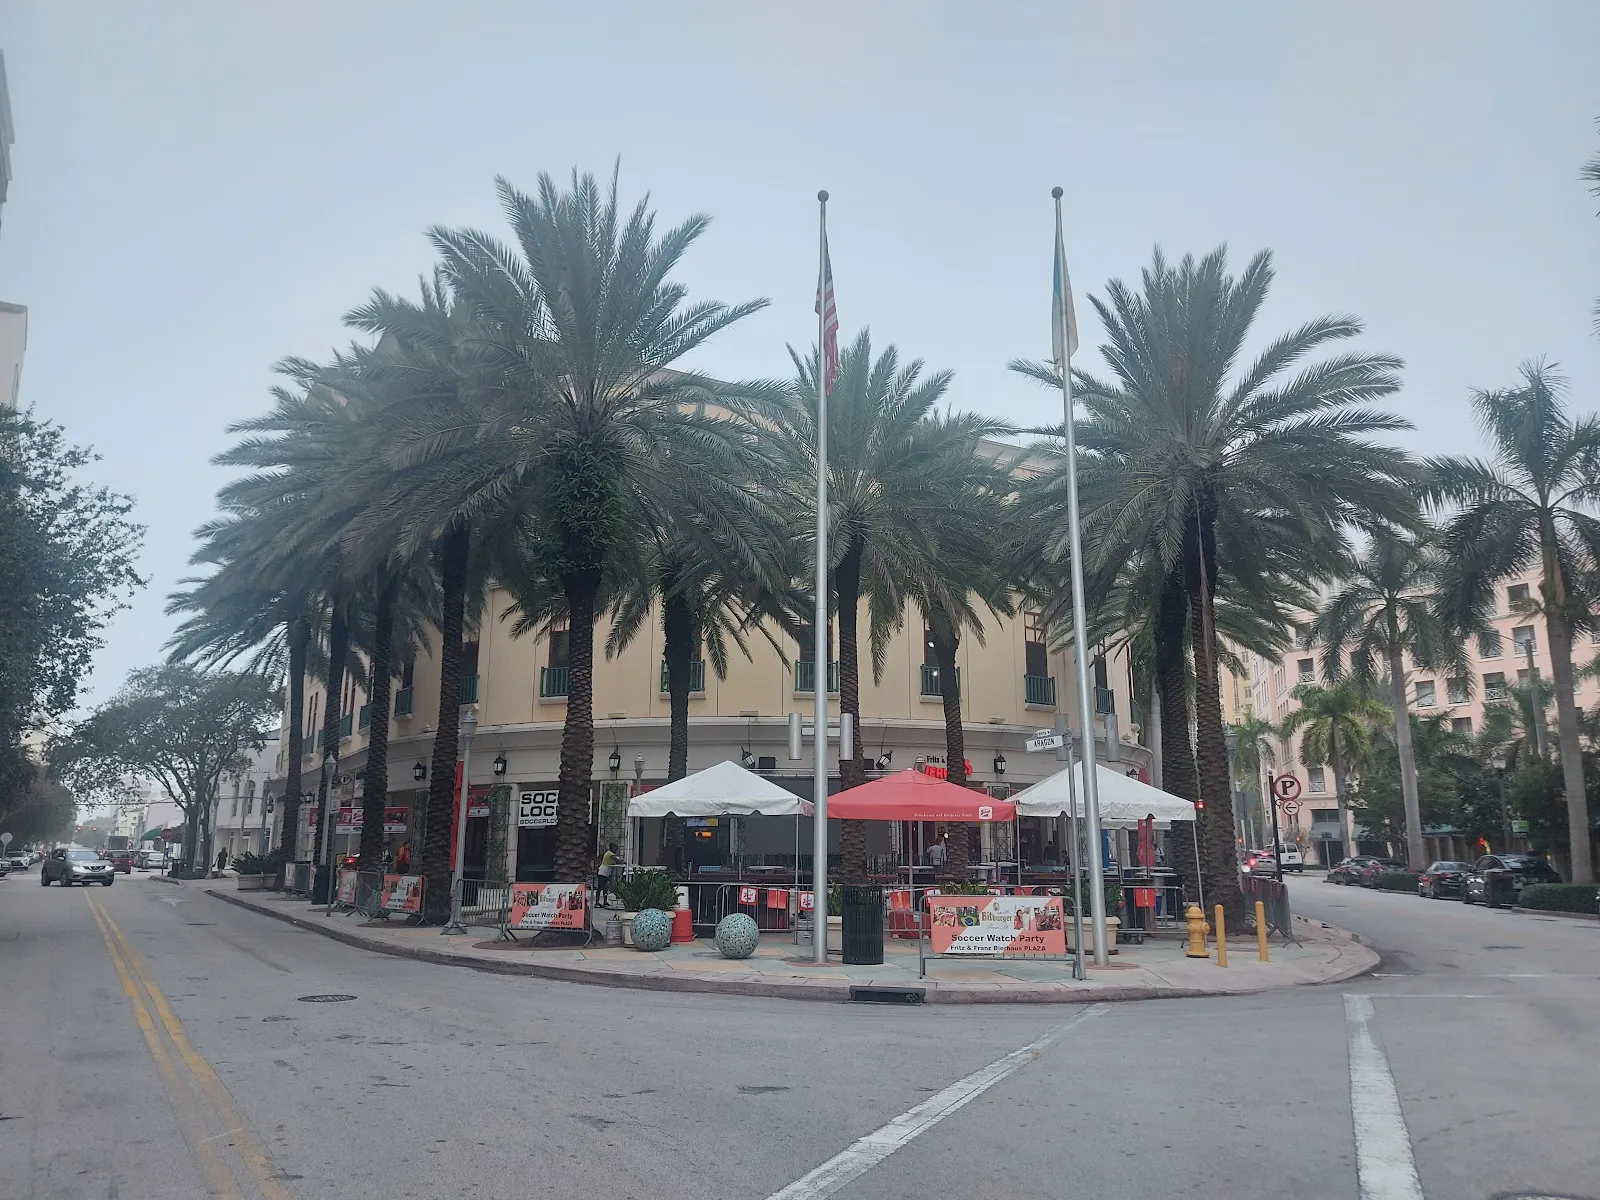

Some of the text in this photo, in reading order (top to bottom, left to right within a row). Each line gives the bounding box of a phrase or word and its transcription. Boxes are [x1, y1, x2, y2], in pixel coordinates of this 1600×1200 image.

[926, 755, 940, 764] Fritz
[1281, 780, 1295, 796] P
[521, 792, 560, 805] SOC
[520, 805, 559, 817] LOC
[558, 912, 573, 920] Party
[981, 911, 1012, 923] Bitburger
[951, 934, 1045, 943] Soccer Watch Party
